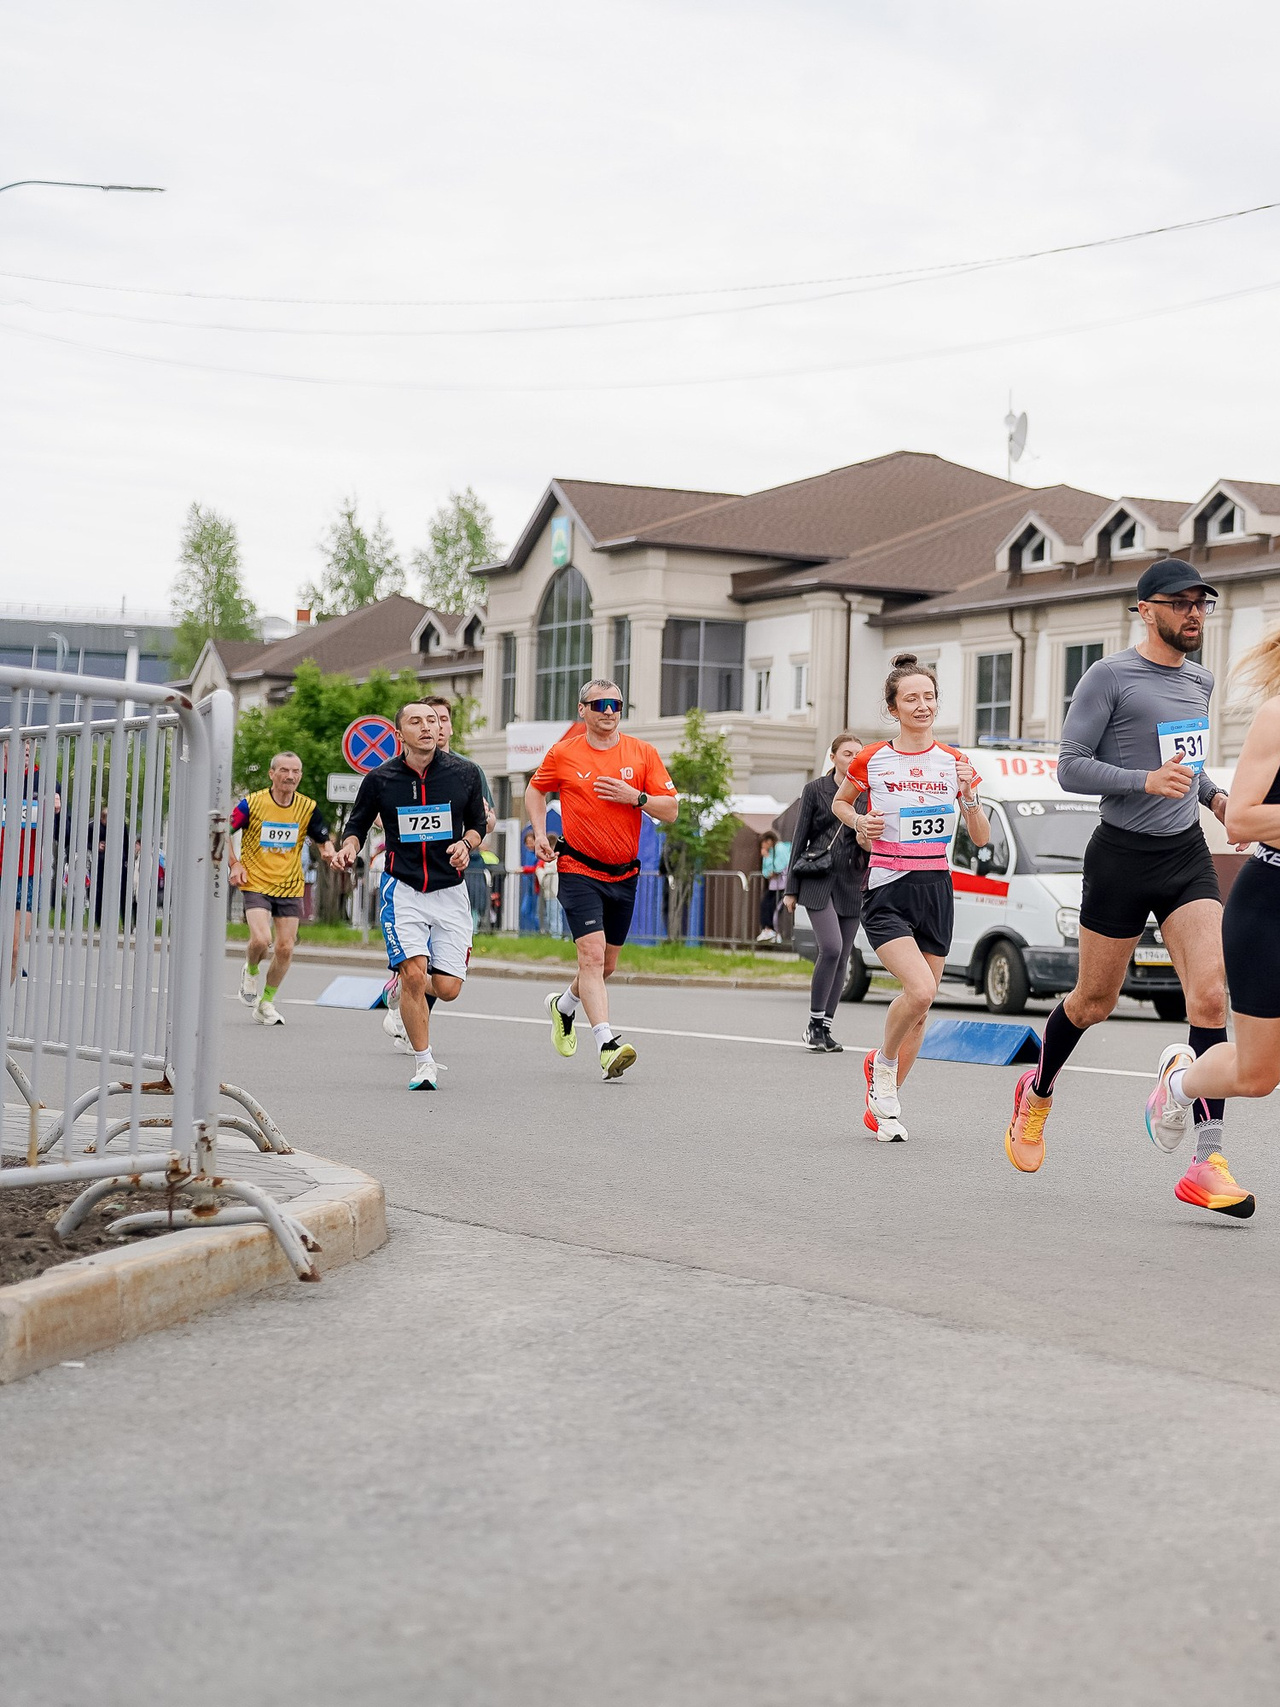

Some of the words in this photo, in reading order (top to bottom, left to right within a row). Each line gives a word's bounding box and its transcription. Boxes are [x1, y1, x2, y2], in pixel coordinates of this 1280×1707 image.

[1174, 734, 1203, 757] 531
[620, 766, 634, 780] 10
[996, 757, 1046, 776] 103
[1016, 802, 1046, 816] 03
[409, 815, 441, 831] 725
[911, 818, 945, 836] 533
[269, 830, 291, 841] 899
